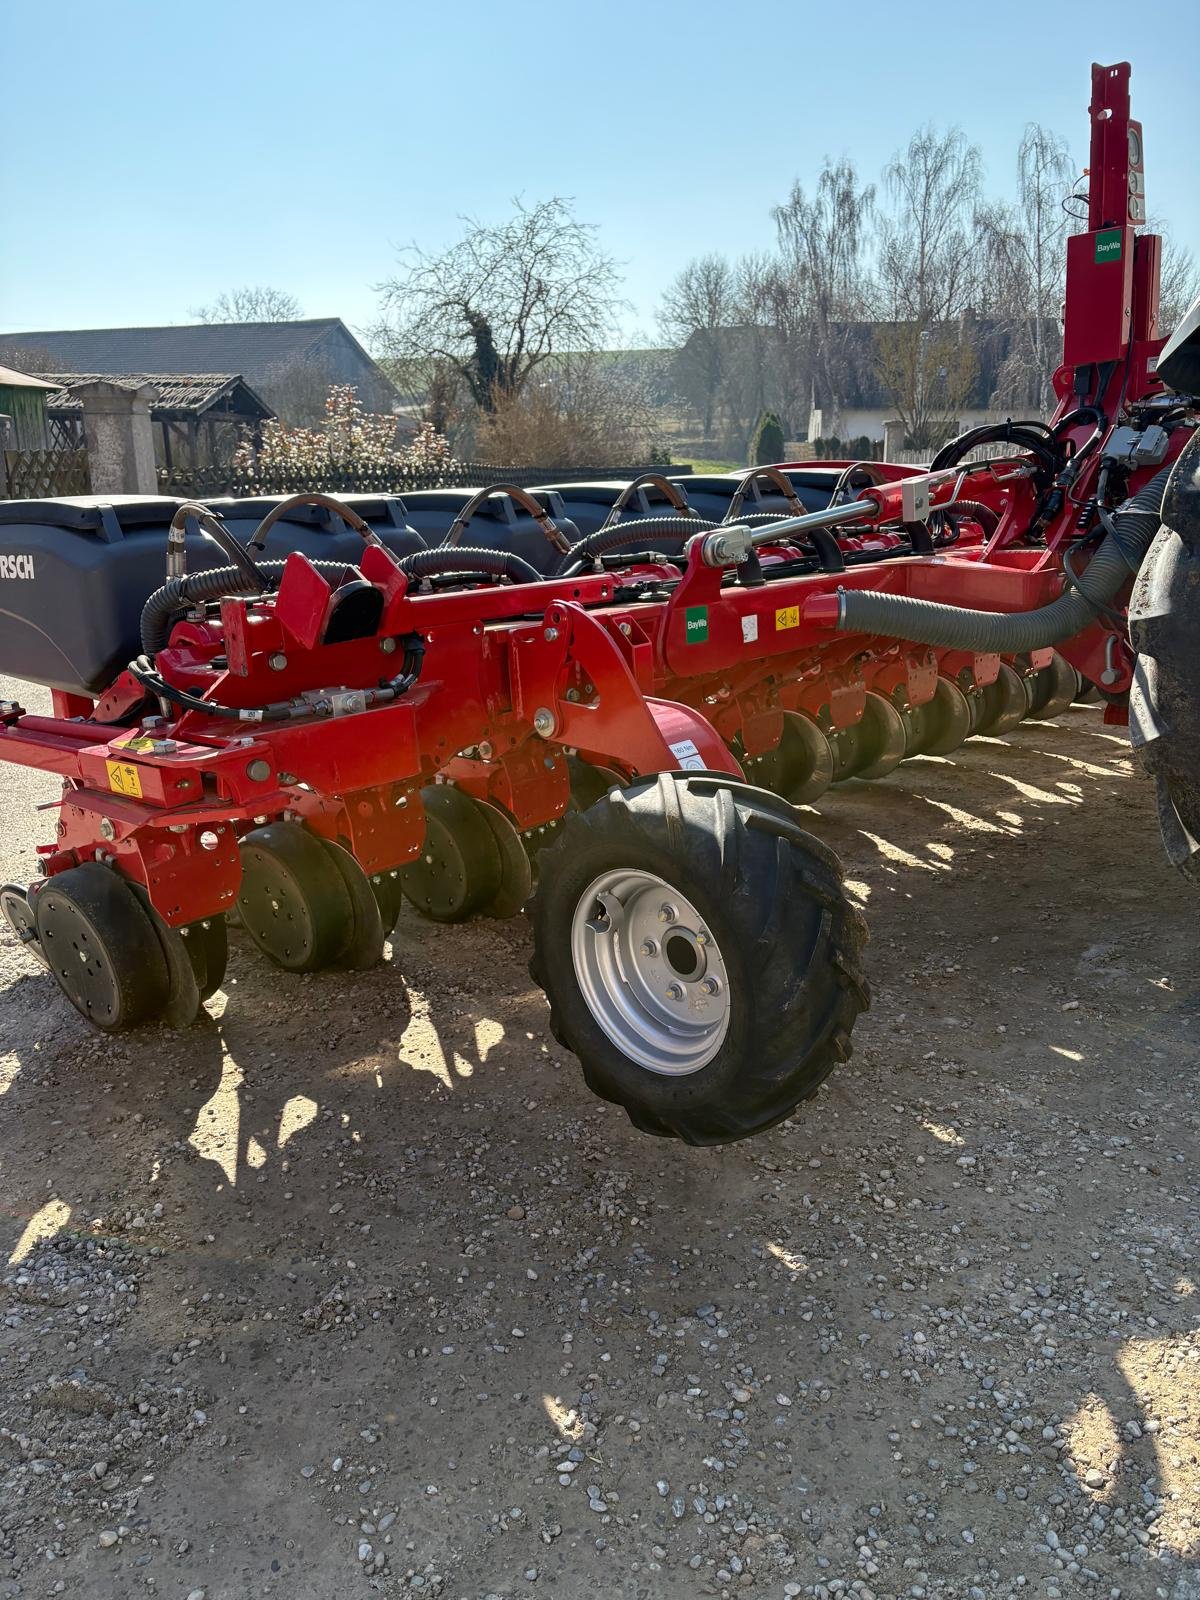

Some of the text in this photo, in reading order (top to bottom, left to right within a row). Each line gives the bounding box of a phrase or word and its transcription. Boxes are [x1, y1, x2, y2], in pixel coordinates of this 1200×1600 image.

[1097, 242, 1121, 252] BayWa
[0, 555, 35, 579] RSCH
[687, 618, 707, 630] BayWa
